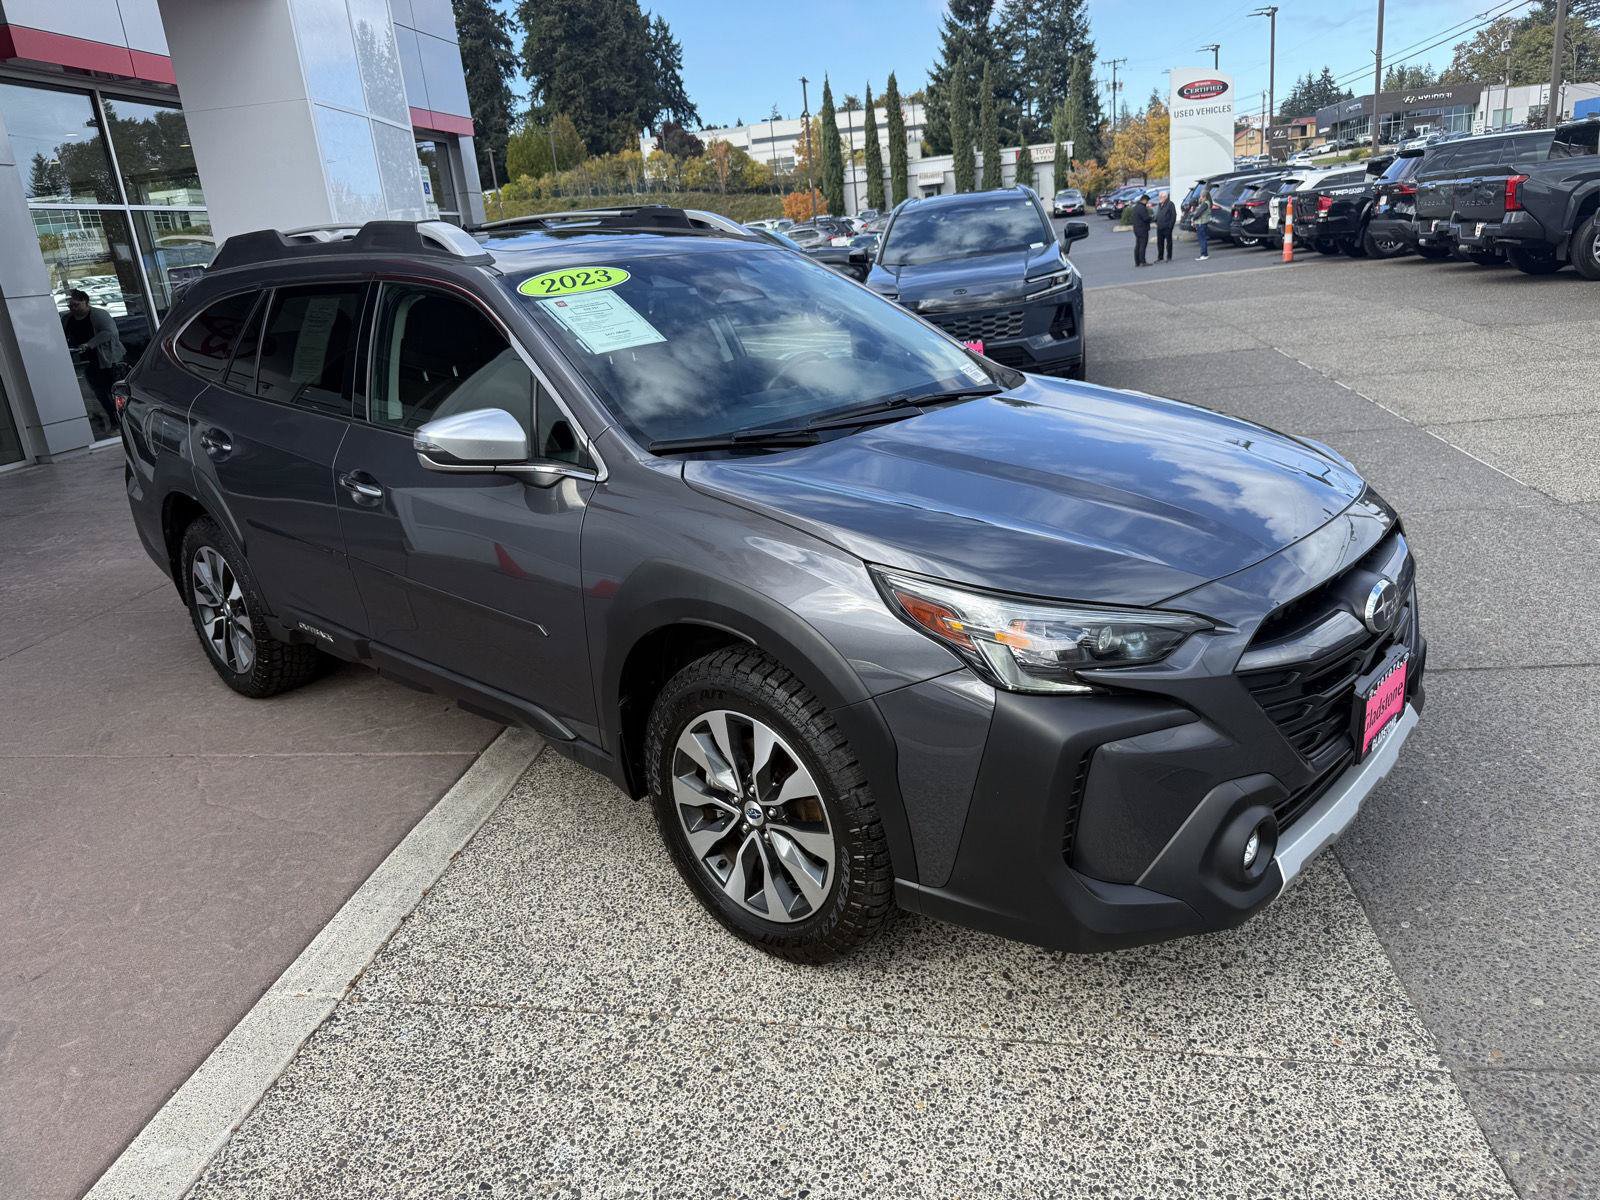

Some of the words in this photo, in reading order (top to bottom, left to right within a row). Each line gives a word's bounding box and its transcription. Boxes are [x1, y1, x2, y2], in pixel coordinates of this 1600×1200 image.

[1183, 85, 1223, 95] CERTIFIED
[1174, 109, 1194, 119] USED
[1196, 105, 1232, 116] VEHICLES
[540, 269, 613, 293] 2023
